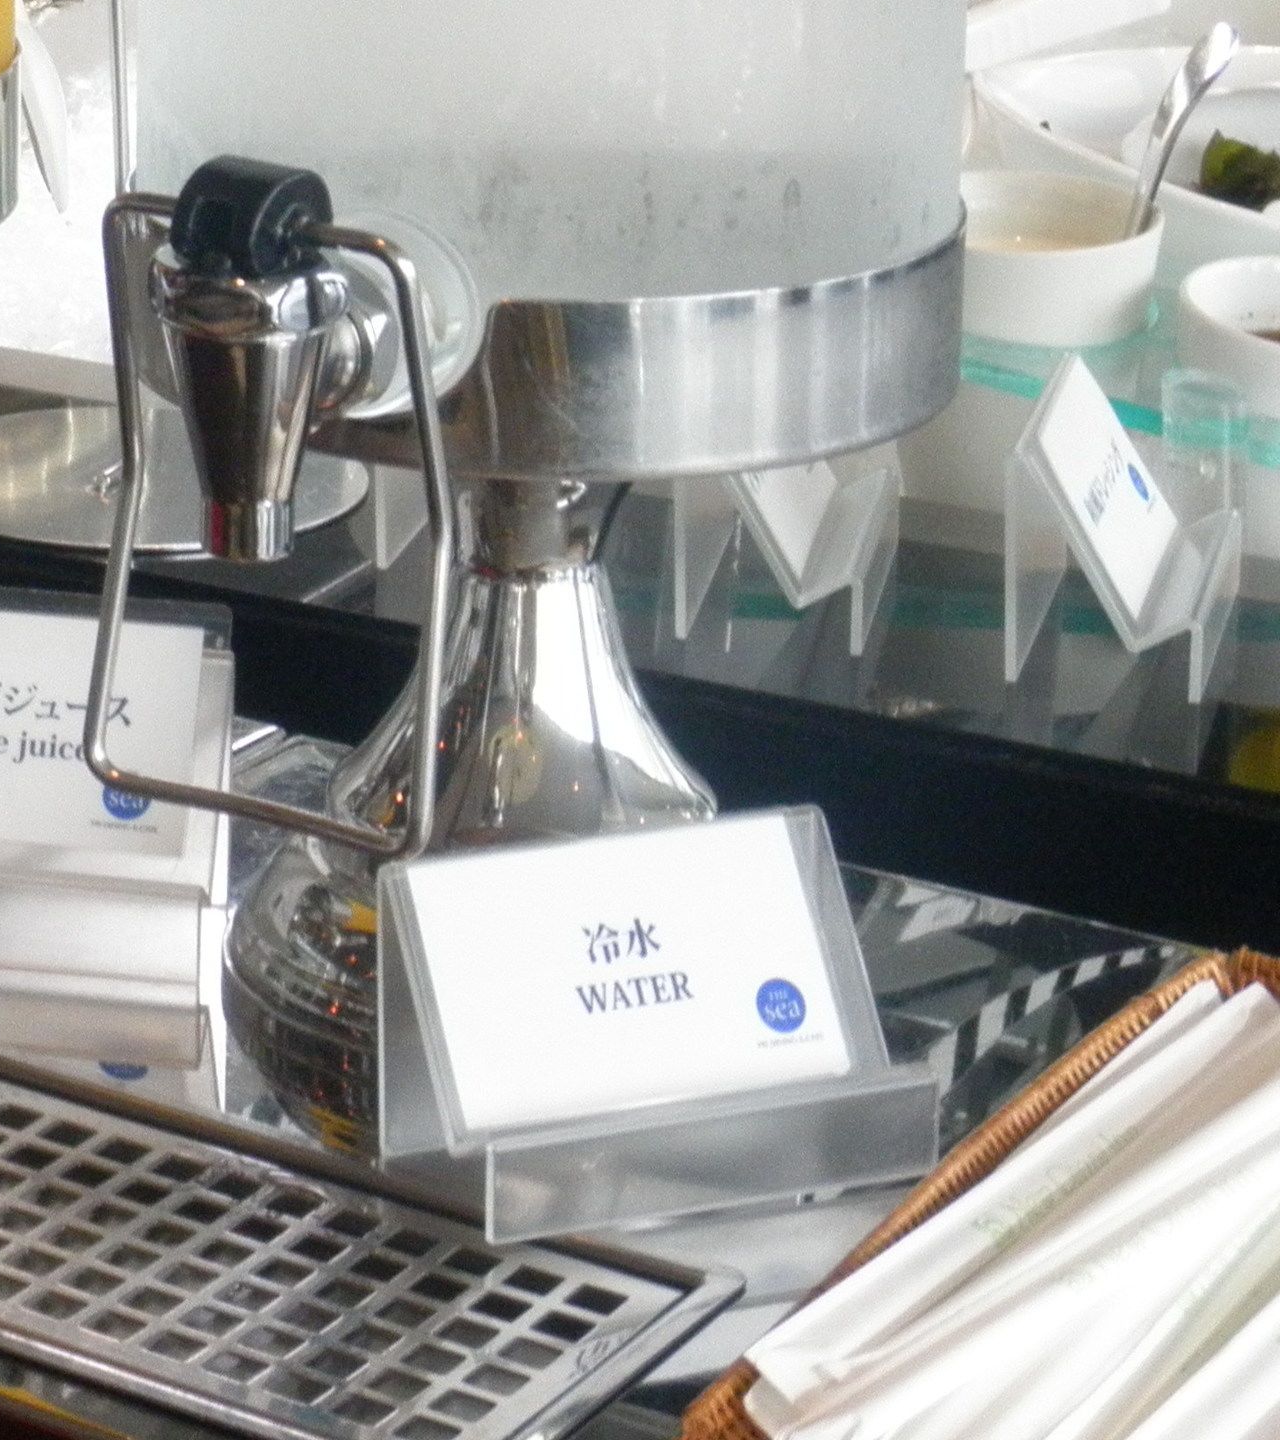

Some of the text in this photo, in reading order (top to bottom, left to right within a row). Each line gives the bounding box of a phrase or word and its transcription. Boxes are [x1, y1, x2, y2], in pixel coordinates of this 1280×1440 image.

[581, 917, 661, 964] 冷水
[575, 971, 694, 1014] WATER
[765, 1000, 801, 1021] sea
